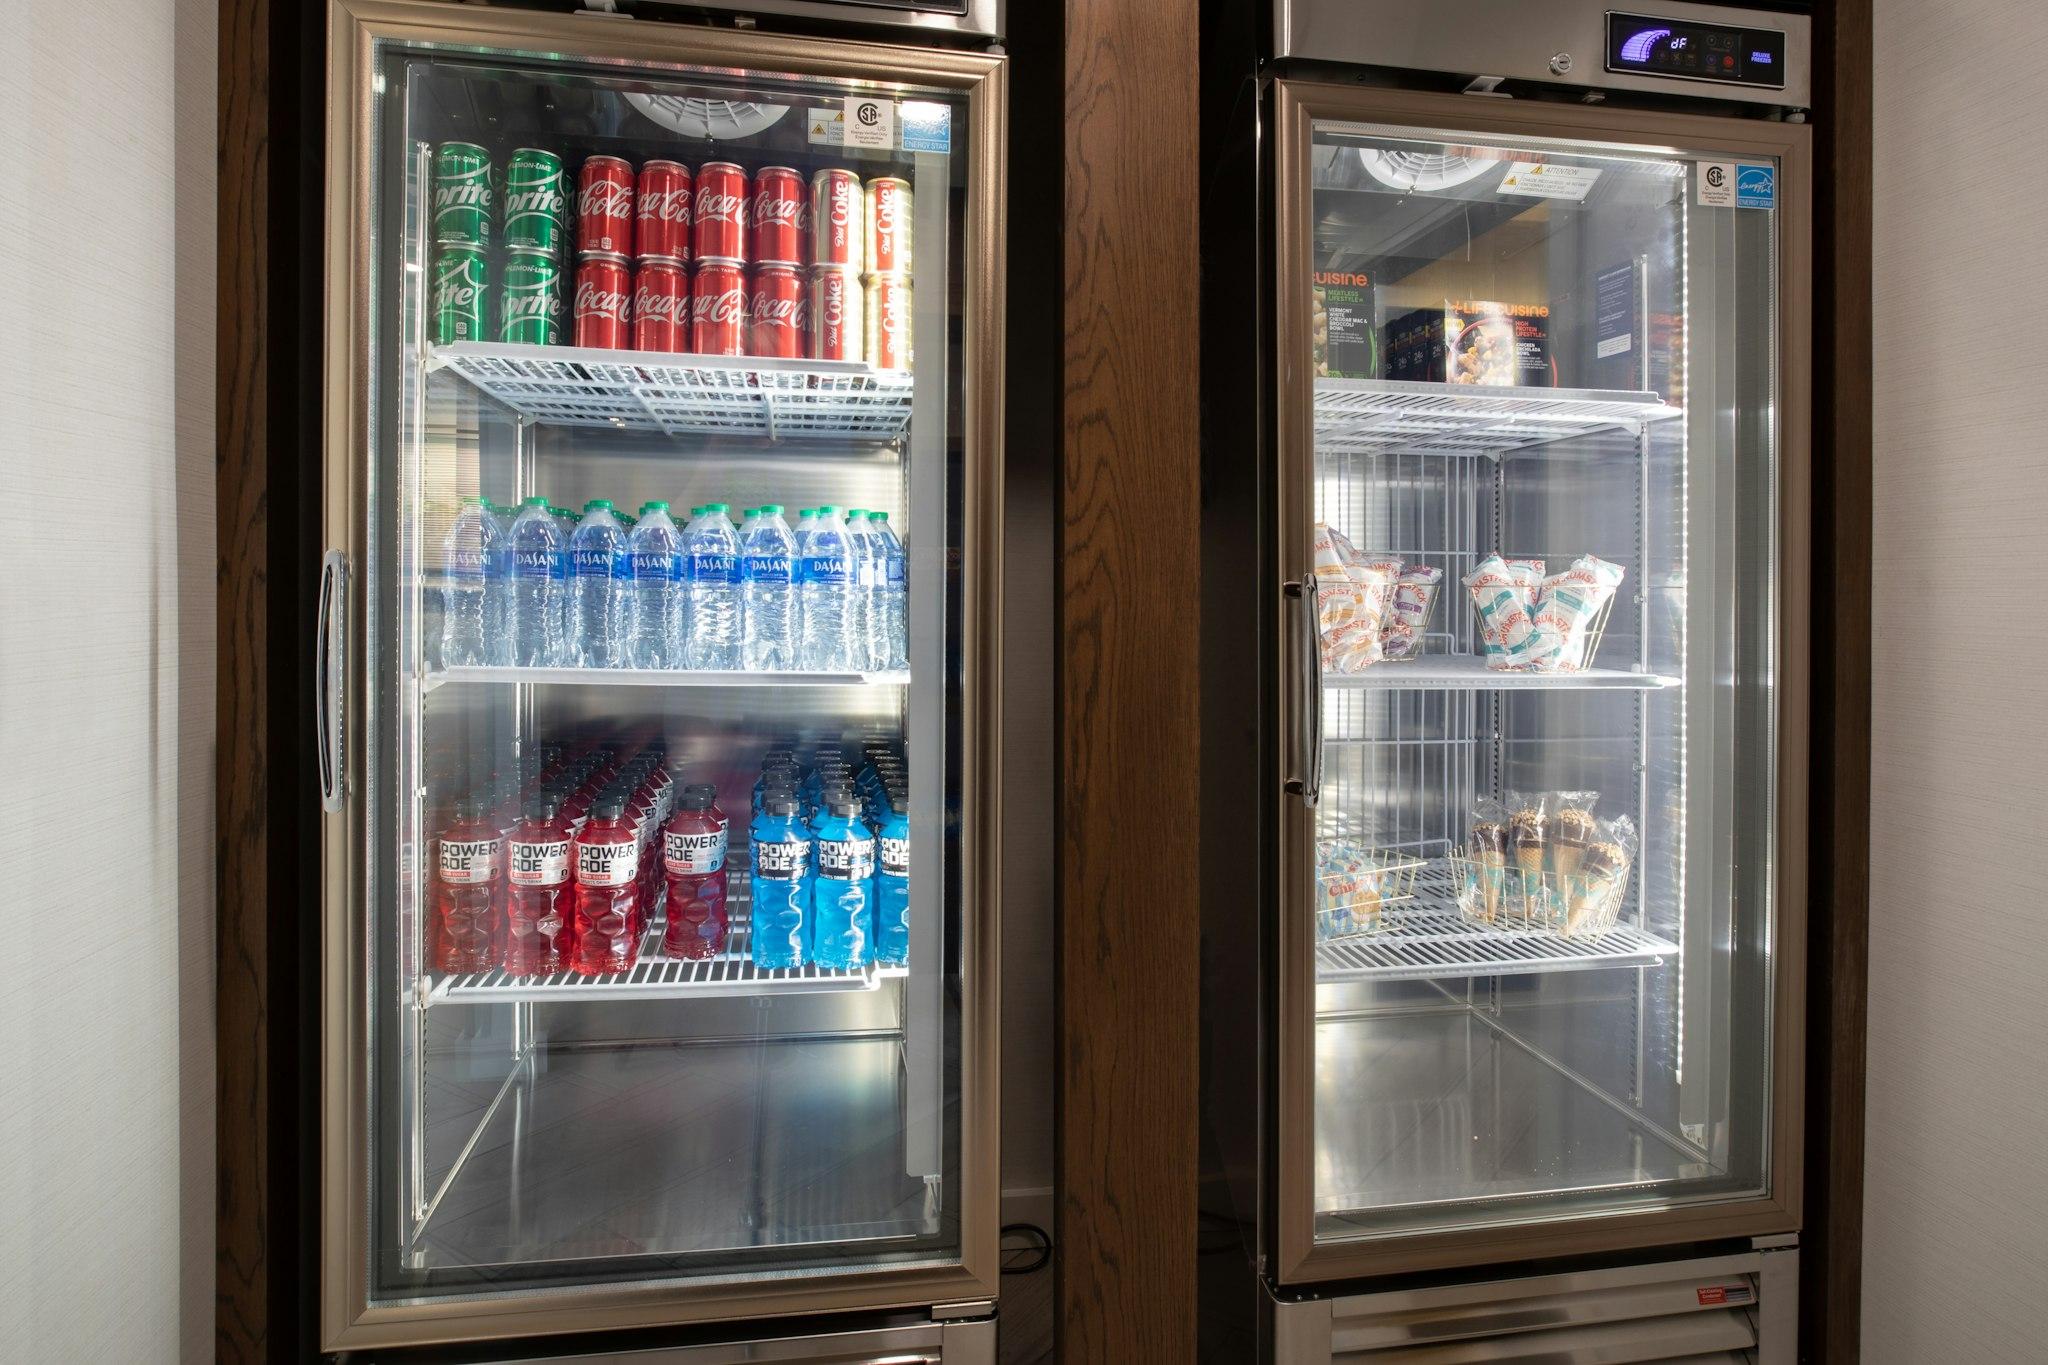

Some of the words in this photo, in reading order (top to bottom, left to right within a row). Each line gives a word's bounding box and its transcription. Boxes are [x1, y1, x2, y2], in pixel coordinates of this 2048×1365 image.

[905, 141, 930, 149] ENERGY
[932, 143, 947, 151] STAR
[1546, 167, 1578, 175] ATTENTION
[831, 181, 848, 225] Coke
[1314, 271, 1368, 287] uisine
[825, 280, 842, 326] Coke
[450, 552, 492, 567] DASANI
[516, 553, 558, 567] DASANI
[573, 552, 614, 567] DASANI
[632, 555, 673, 569] DASANI
[695, 558, 734, 572] DASANI
[752, 558, 790, 572] DASAN
[442, 842, 498, 856] POWER
[666, 835, 718, 849] POWER
[819, 840, 871, 857] POWER
[881, 838, 909, 854] POW
[512, 843, 568, 858] POWER
[580, 844, 635, 860] POWER
[666, 848, 693, 862] ADE
[758, 841, 811, 858] POWER
[441, 857, 471, 870] ADE
[512, 858, 543, 872] ADE
[580, 860, 611, 873] ADE
